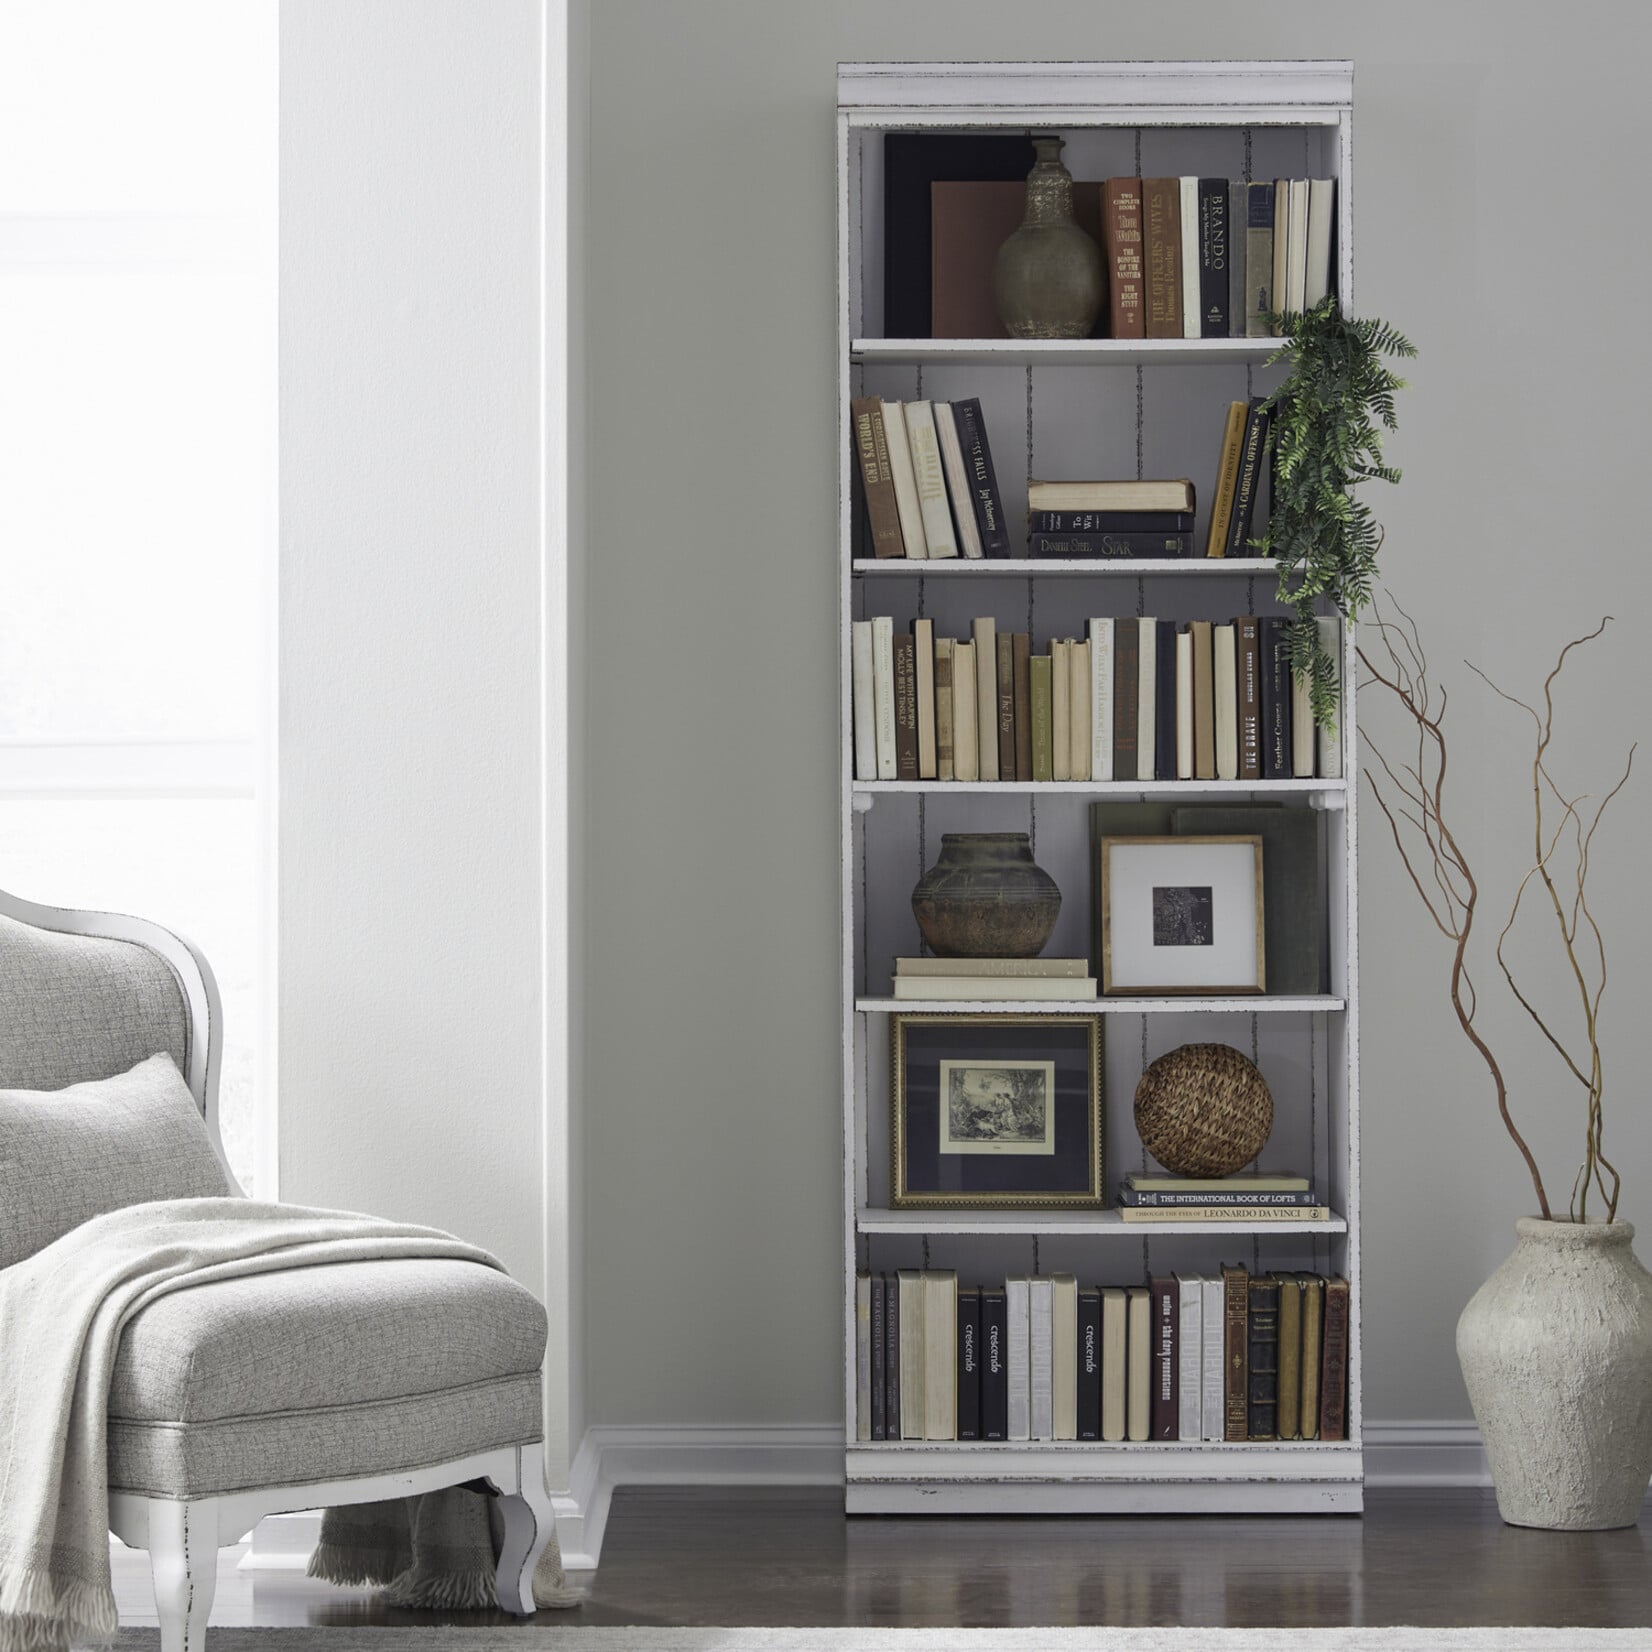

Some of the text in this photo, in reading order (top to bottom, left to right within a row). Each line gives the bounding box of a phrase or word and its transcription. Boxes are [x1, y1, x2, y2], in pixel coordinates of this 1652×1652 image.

[1152, 193, 1162, 234] WIVES
[1212, 196, 1224, 270] BRANDO
[1152, 302, 1164, 321] THE
[859, 413, 878, 484] WORLD'S END
[974, 457, 987, 480] FALLS
[1240, 463, 1254, 502] CARDINAL
[1247, 424, 1260, 460] OFFENSE
[980, 488, 990, 500] Jay
[1073, 516, 1081, 528] To
[1084, 515, 1092, 530] Wit
[906, 644, 912, 657] MY
[1002, 696, 1012, 711] The
[1001, 713, 1013, 732] Day
[1245, 716, 1256, 769] THE BRAVE
[1160, 1195, 1175, 1203] THE
[1176, 1195, 1235, 1203] INTERNATIONAL
[1236, 1195, 1258, 1203] BOOK
[1260, 1195, 1270, 1203] OF
[1272, 1195, 1296, 1203] LOFTS
[1204, 1209, 1258, 1217] LEONARDO
[1259, 1209, 1272, 1217] DA
[1273, 1209, 1300, 1217] VINCI
[1162, 1326, 1173, 1338] the
[965, 1324, 976, 1372] crescendo
[991, 1325, 1002, 1373] crescendo
[1086, 1325, 1097, 1373] crescendo
